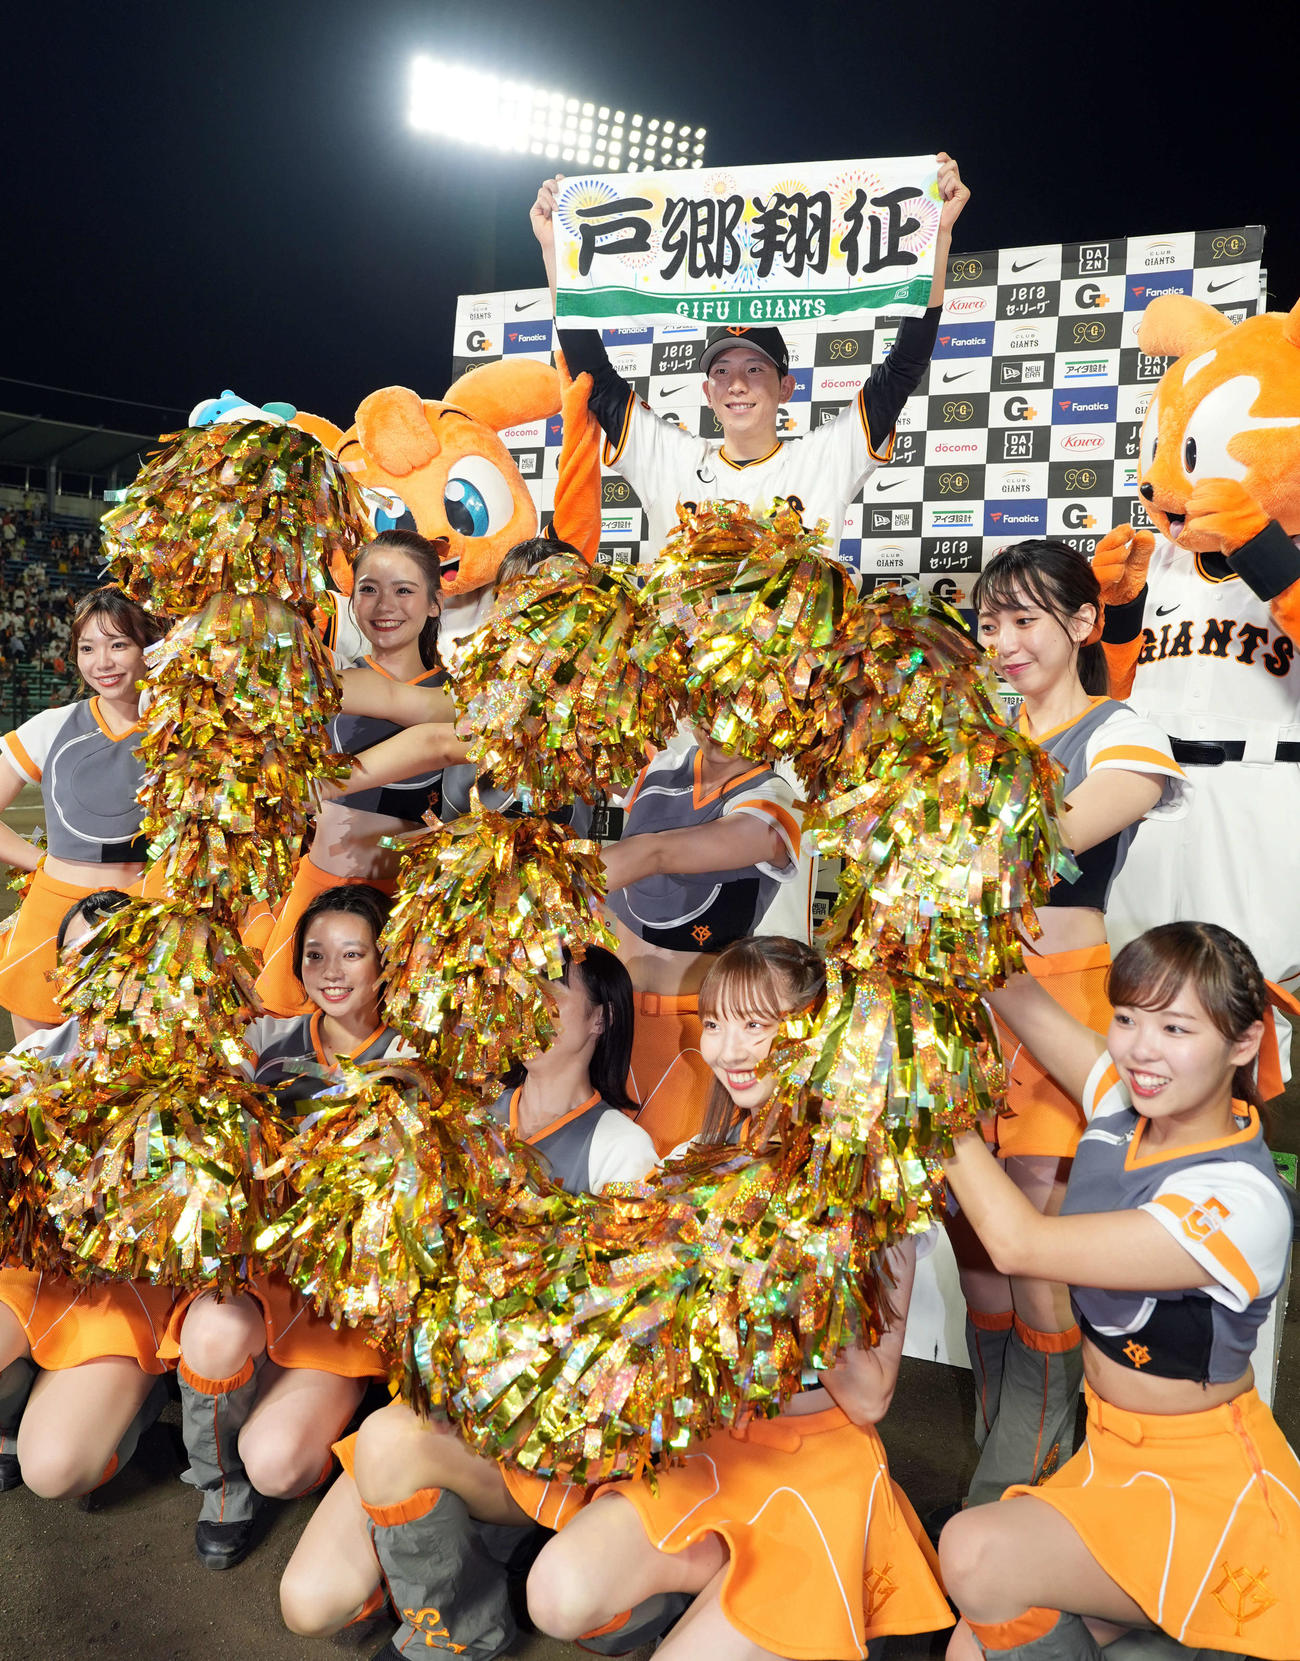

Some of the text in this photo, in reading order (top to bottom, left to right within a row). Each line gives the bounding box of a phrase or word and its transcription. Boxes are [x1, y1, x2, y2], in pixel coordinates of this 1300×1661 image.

[575, 186, 924, 281] 戸郷翔征
[1144, 256, 1176, 266] GIANTS
[1145, 286, 1185, 298] Fanatics
[676, 298, 826, 320] GIFU GIANTS
[948, 298, 985, 311] Kowa
[469, 312, 492, 321] GIANTS
[518, 333, 547, 342] Fanatics
[951, 336, 986, 347] Fanatics
[1010, 339, 1039, 349] GIANTS
[1065, 363, 1107, 375] アイダ設計
[1024, 371, 1041, 379] ERA
[1071, 402, 1109, 412] Fanatics
[504, 429, 539, 437] docomo
[1064, 436, 1103, 448] Kowa
[1001, 484, 1031, 493] GIANTS
[934, 514, 972, 524] アイダ設計
[1003, 514, 1040, 524] Fanatics
[876, 559, 904, 567] GIANTS
[1137, 617, 1295, 678] GIANTS
